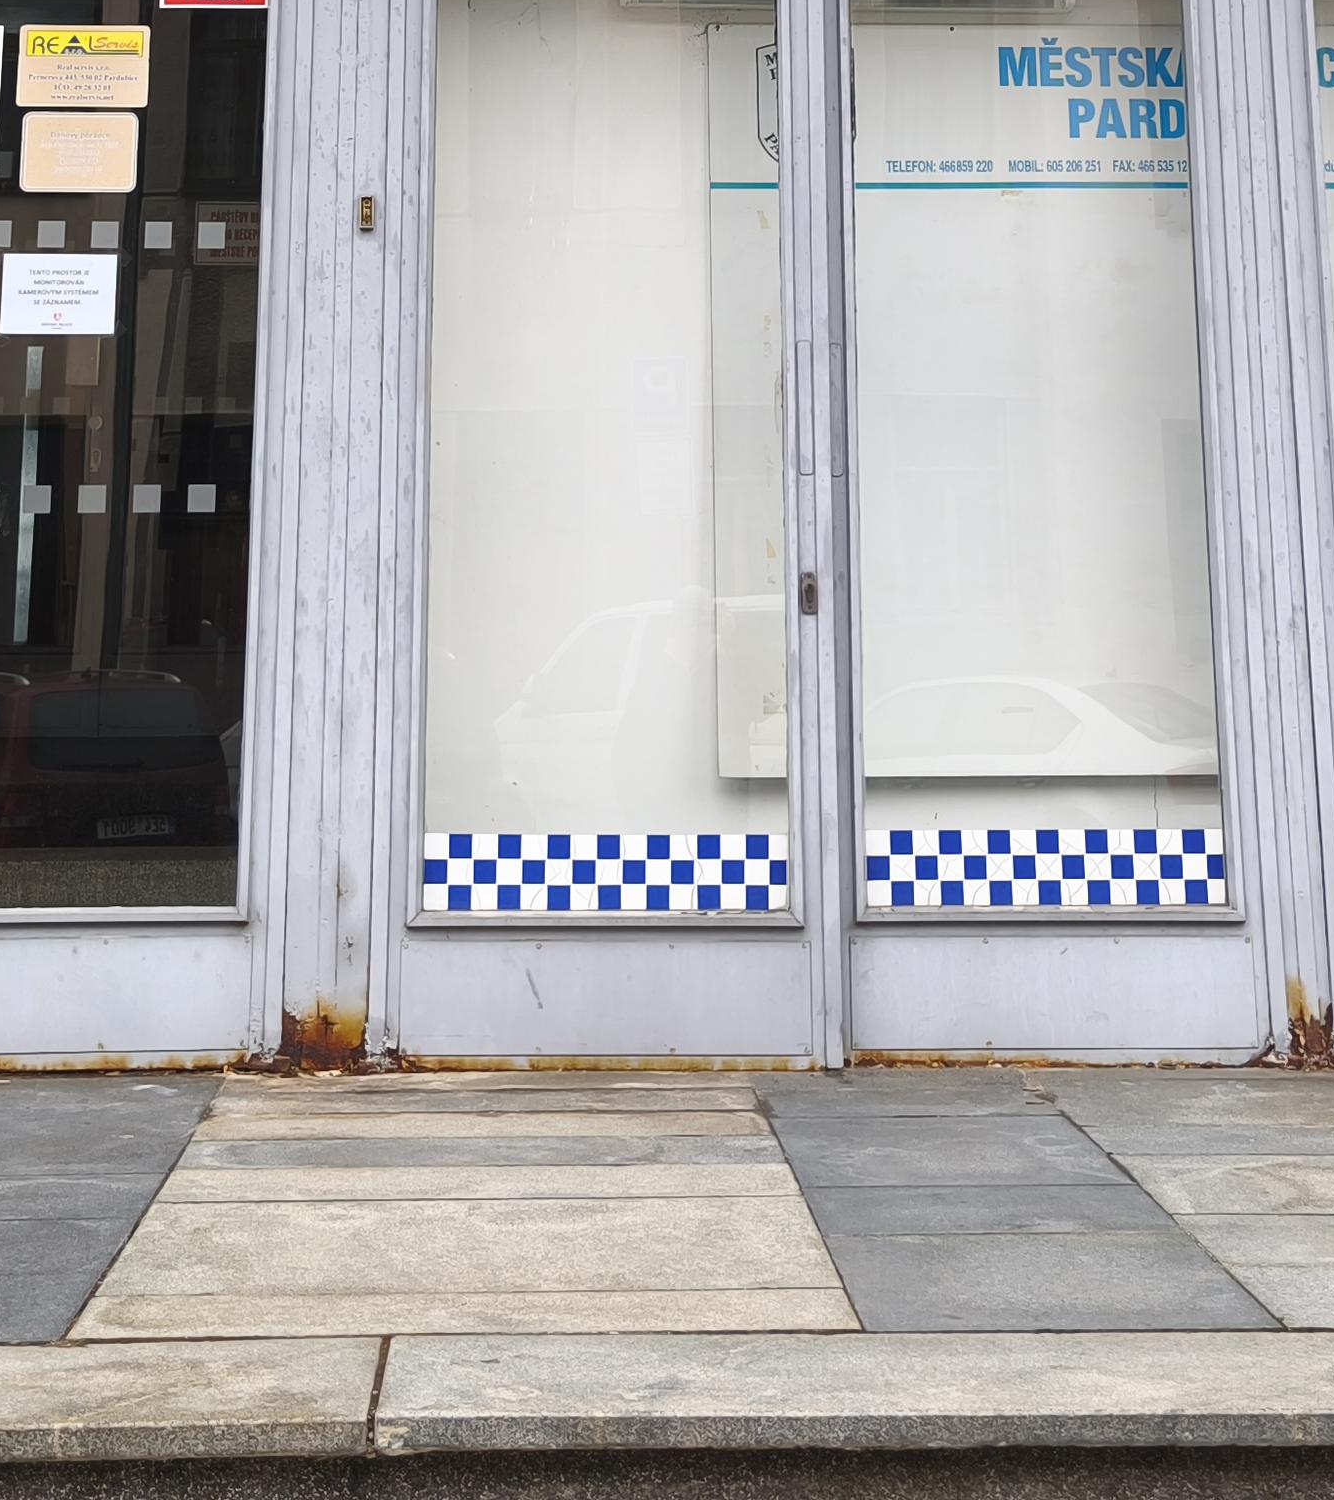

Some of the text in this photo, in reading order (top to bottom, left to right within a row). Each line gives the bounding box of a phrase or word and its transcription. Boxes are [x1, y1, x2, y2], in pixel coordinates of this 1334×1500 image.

[886, 160, 936, 173] TELEFON:
[975, 160, 993, 173] 220
[1008, 160, 1044, 173] MOBIL:
[1046, 160, 1064, 173] 605
[1065, 160, 1083, 173] 206
[1084, 160, 1102, 173] 251
[1112, 160, 1136, 173] FAX:
[1137, 160, 1155, 173] 466
[1157, 160, 1175, 173] 535
